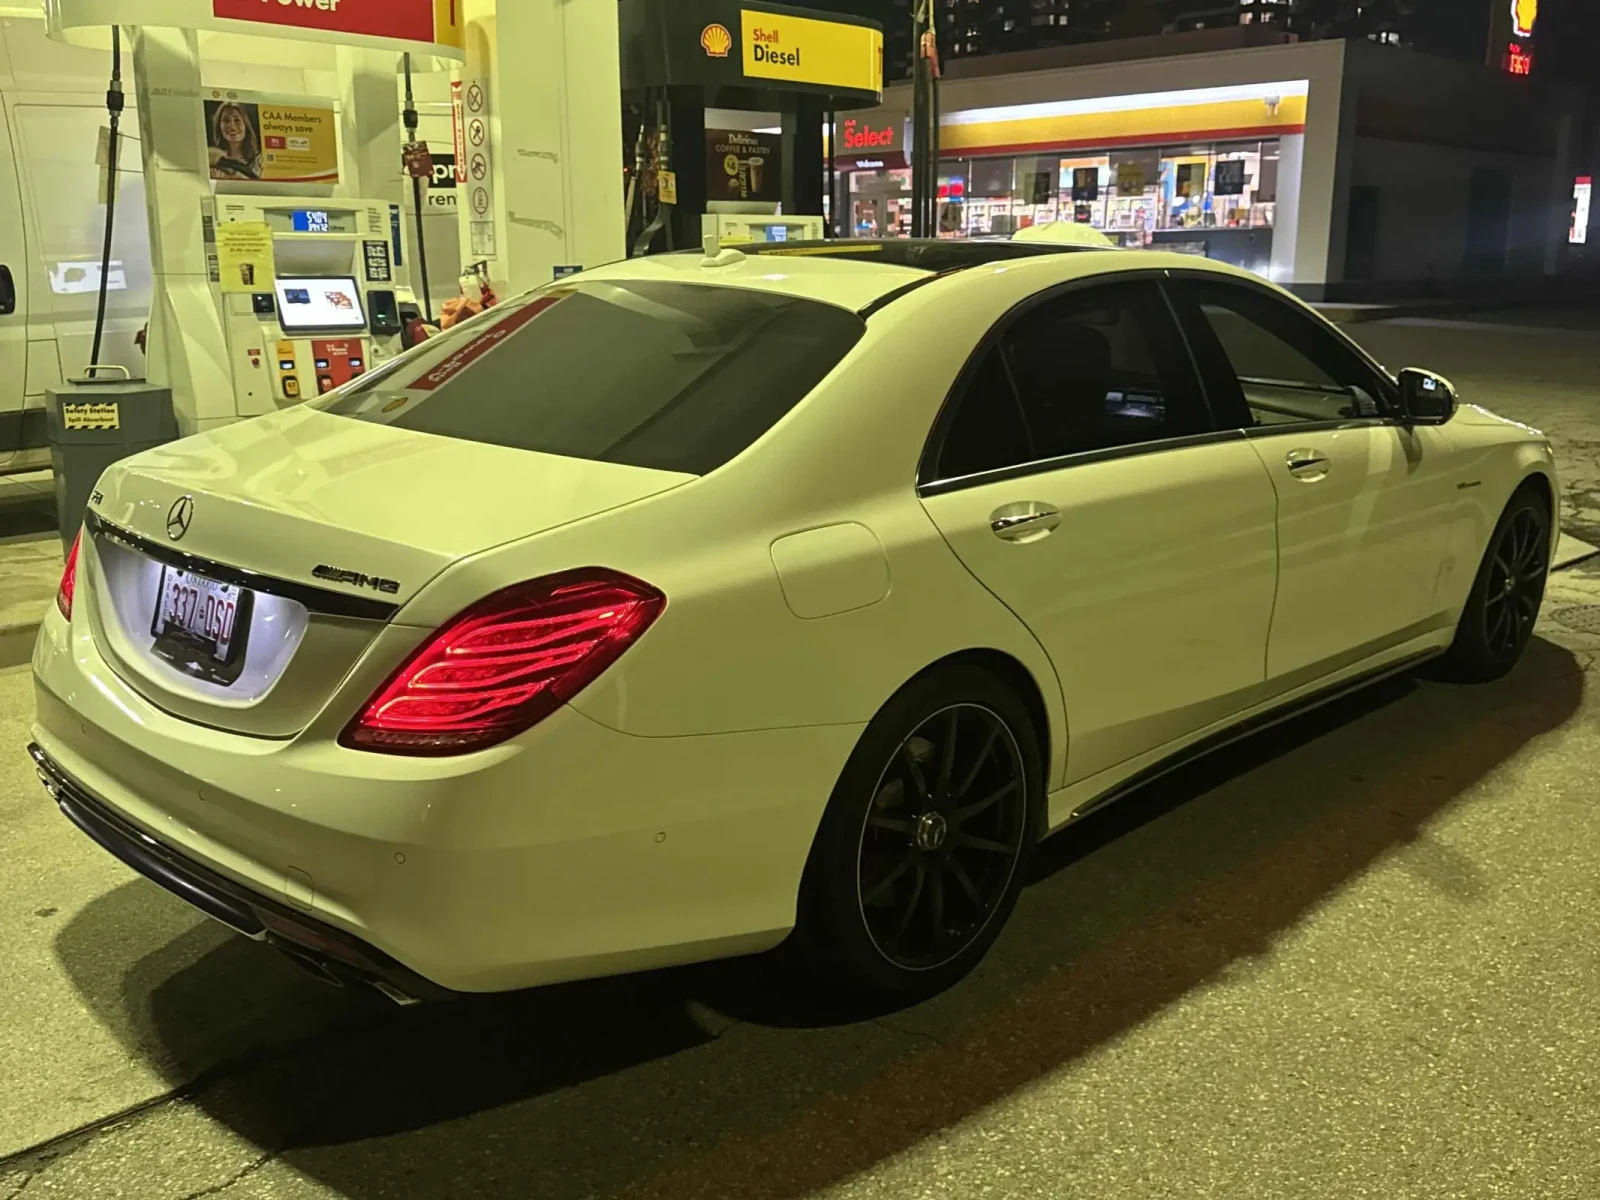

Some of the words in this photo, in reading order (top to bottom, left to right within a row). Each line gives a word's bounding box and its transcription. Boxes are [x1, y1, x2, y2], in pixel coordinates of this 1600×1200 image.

[753, 28, 779, 43] Shell
[753, 44, 800, 66] Diesel
[262, 111, 282, 121] CAA
[284, 113, 321, 123] Members
[263, 121, 293, 133] always
[295, 125, 313, 133] save
[844, 125, 893, 148] Select
[716, 144, 740, 154] COFFEE
[748, 146, 770, 154] PASTRY
[65, 407, 88, 415] Safety
[169, 582, 199, 629] 337
